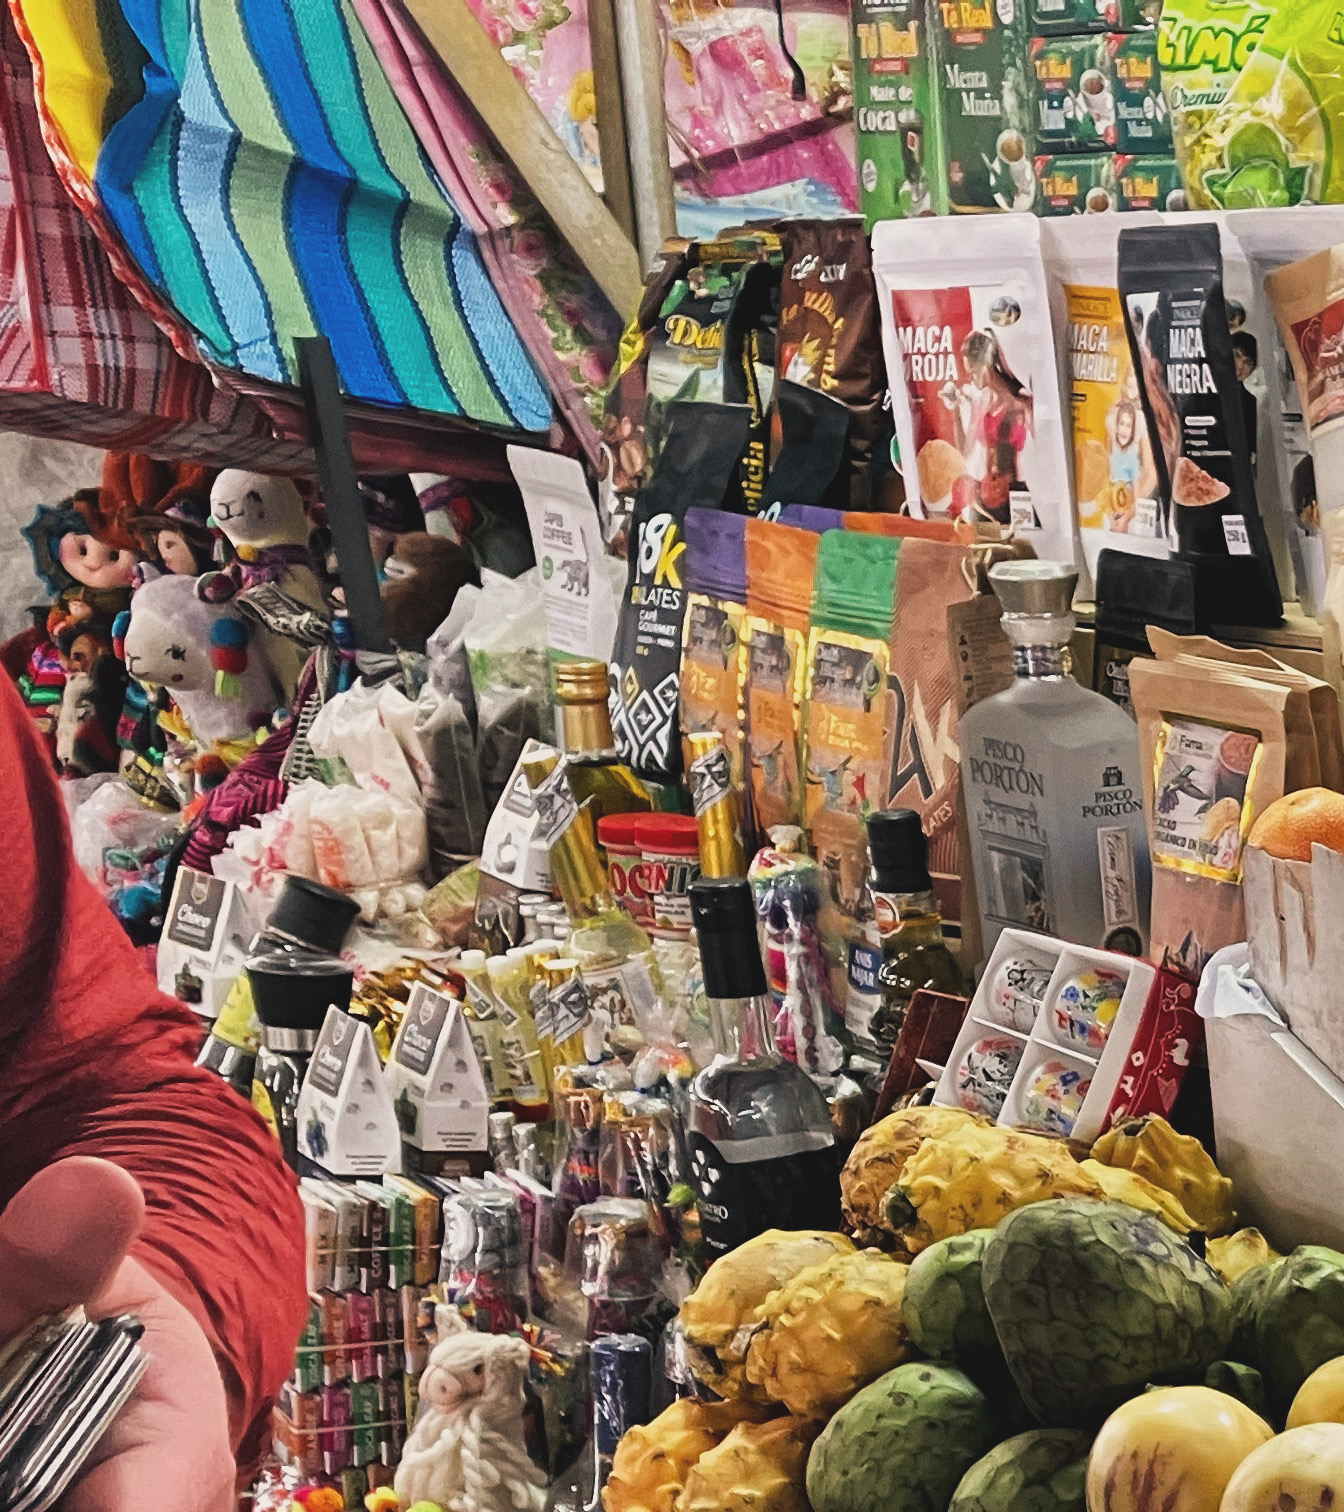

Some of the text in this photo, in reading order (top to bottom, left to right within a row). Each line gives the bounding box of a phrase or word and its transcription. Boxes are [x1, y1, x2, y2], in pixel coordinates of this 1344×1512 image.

[859, 107, 897, 132] Coca
[899, 326, 953, 355] MACA
[1169, 328, 1206, 359] MACA
[911, 354, 959, 382] ROJA
[1167, 363, 1218, 395] NEGRA
[983, 737, 1026, 766] PISCO
[1094, 788, 1133, 804] PISCO
